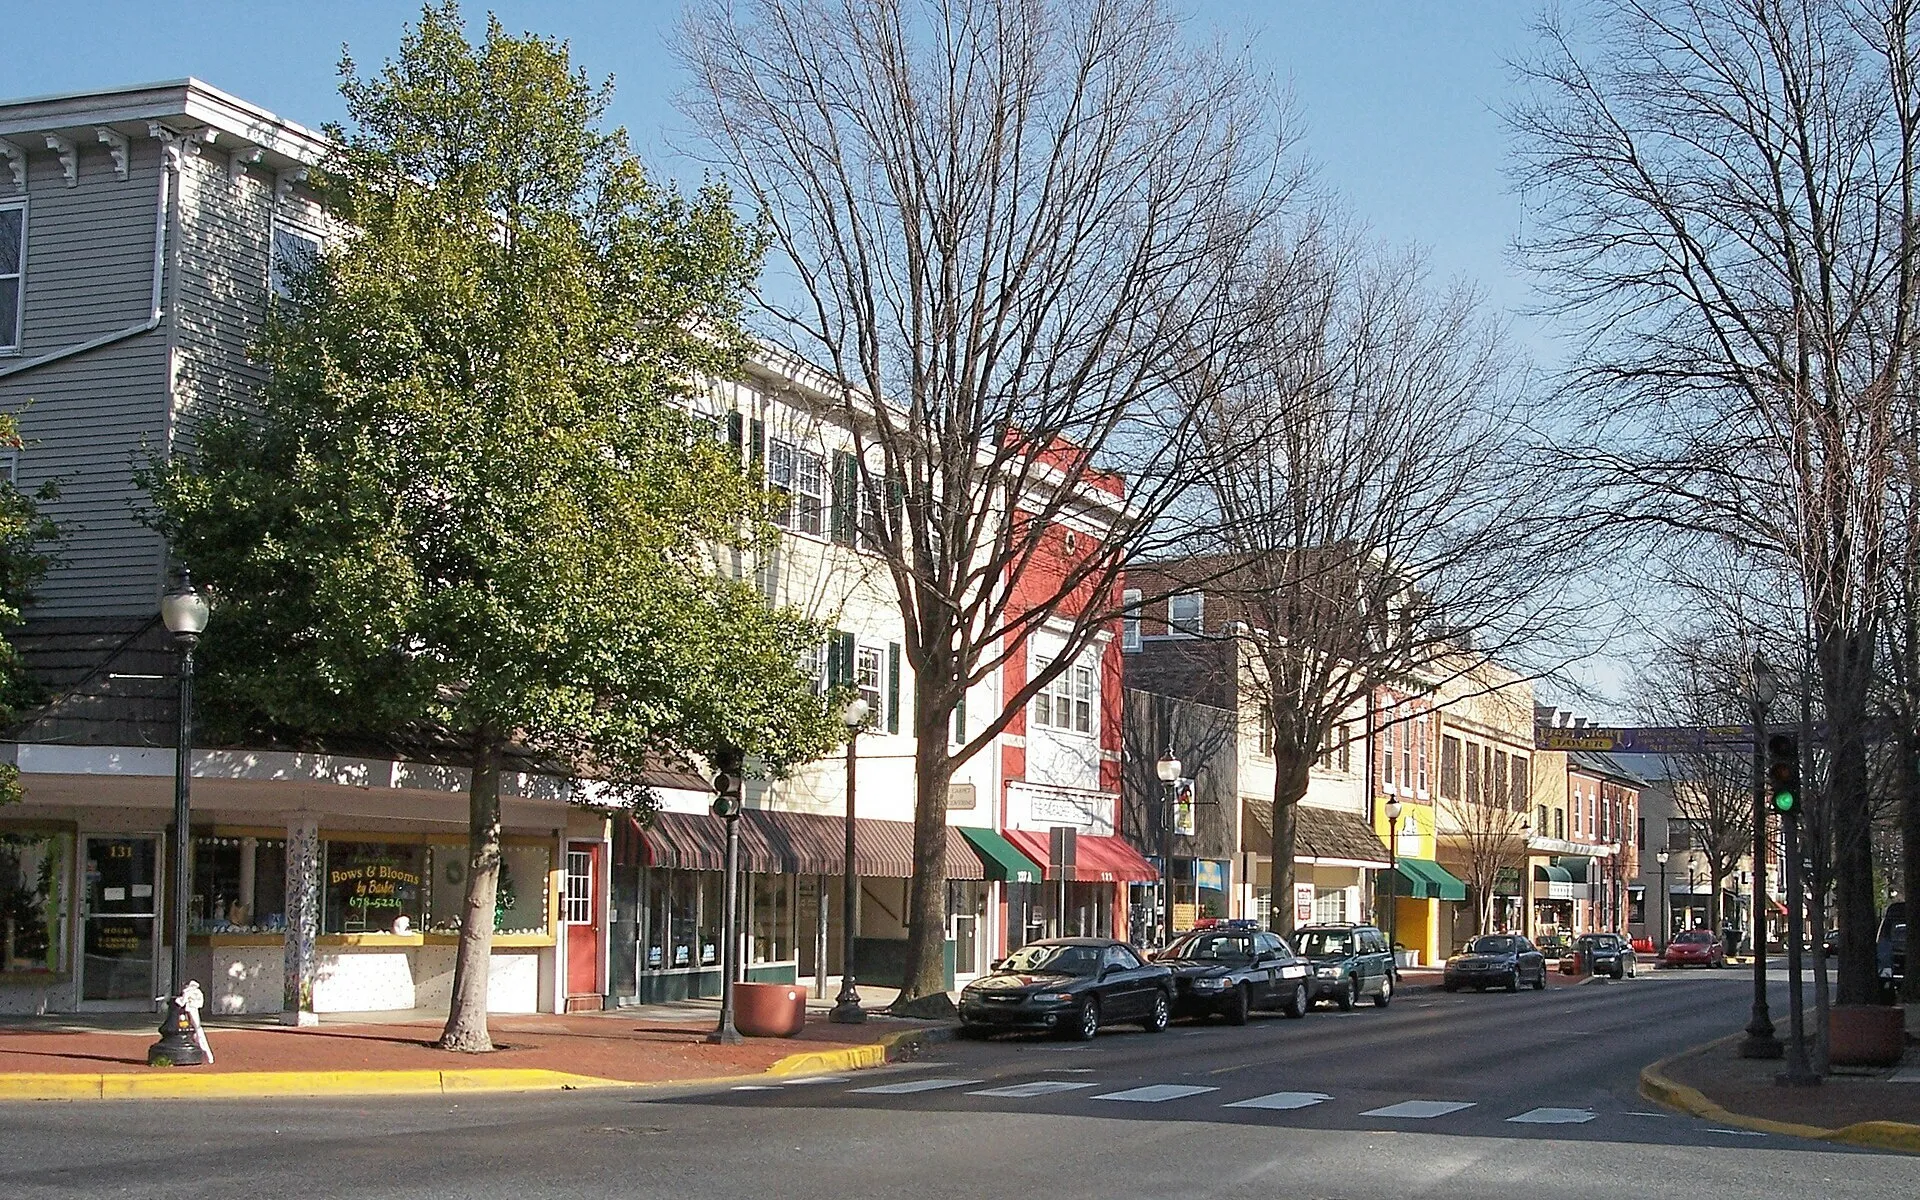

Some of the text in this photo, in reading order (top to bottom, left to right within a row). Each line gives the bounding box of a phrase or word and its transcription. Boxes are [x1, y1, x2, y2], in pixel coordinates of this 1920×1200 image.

[110, 846, 132, 857] 131
[331, 865, 420, 885] Bows & Blooms
[356, 881, 366, 897] by
[350, 897, 402, 908] 678-5226
